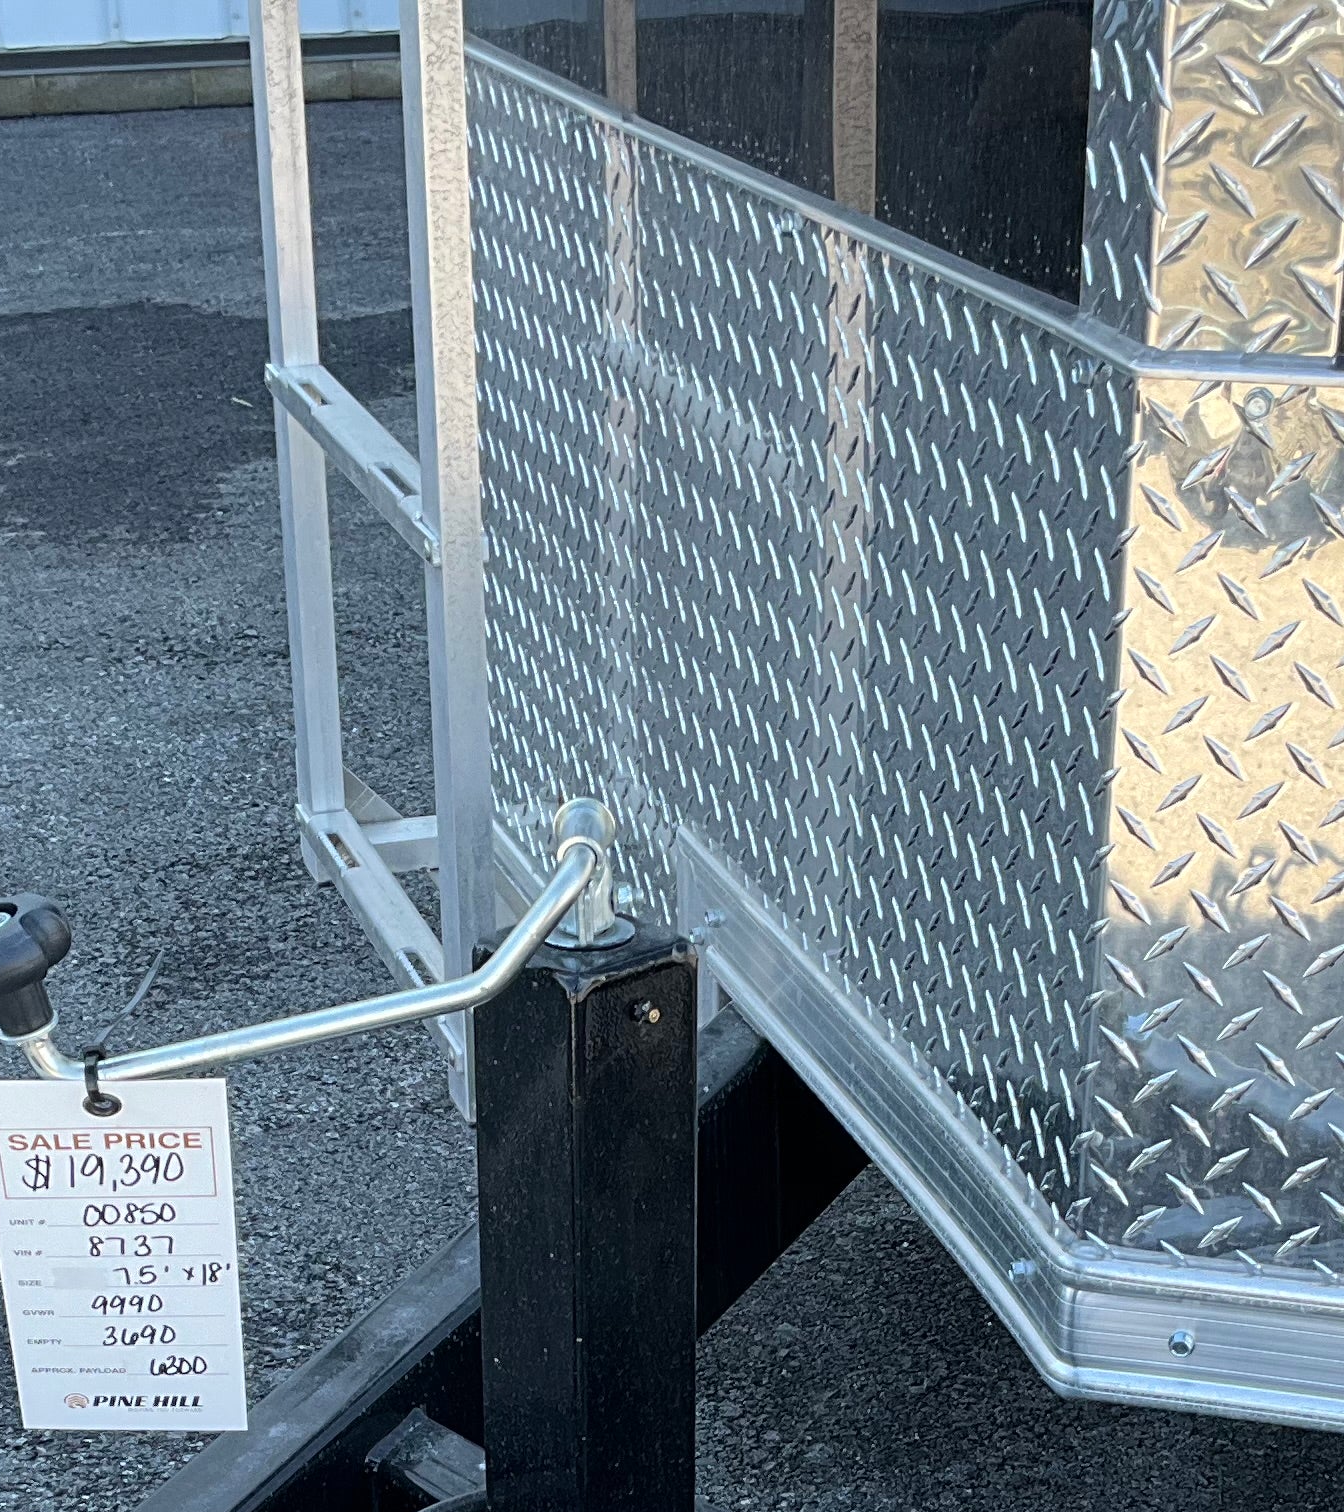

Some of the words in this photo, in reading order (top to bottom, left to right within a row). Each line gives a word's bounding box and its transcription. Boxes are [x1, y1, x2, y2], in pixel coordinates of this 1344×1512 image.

[8, 1133, 92, 1150] SALE
[104, 1132, 202, 1149] PRICE
[84, 1203, 176, 1227] 00850
[90, 1235, 174, 1257] 8737
[91, 1294, 163, 1316] 9990
[103, 1325, 176, 1346] 3690
[79, 1366, 127, 1374] PAYLOAD
[150, 1356, 208, 1376] 6300
[92, 1395, 148, 1408] PINE
[153, 1395, 204, 1408] HILL
